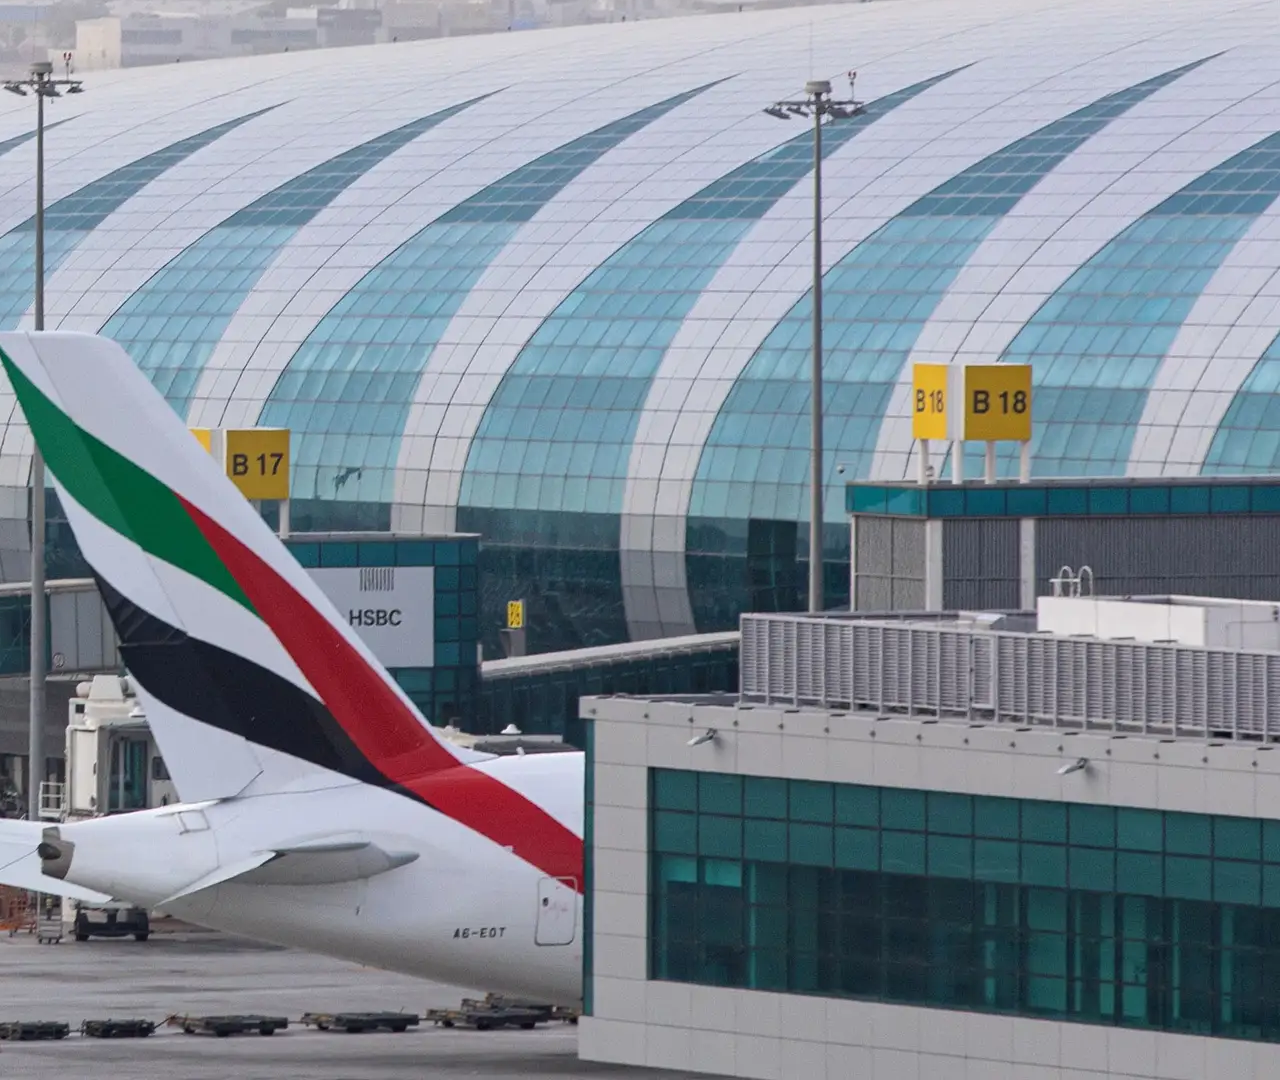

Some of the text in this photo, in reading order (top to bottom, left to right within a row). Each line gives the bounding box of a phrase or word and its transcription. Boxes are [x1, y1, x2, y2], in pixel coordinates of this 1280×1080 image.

[916, 389, 944, 414] B 18
[973, 390, 1027, 414] B 18
[233, 453, 284, 476] B 17
[349, 609, 402, 627] HSBC
